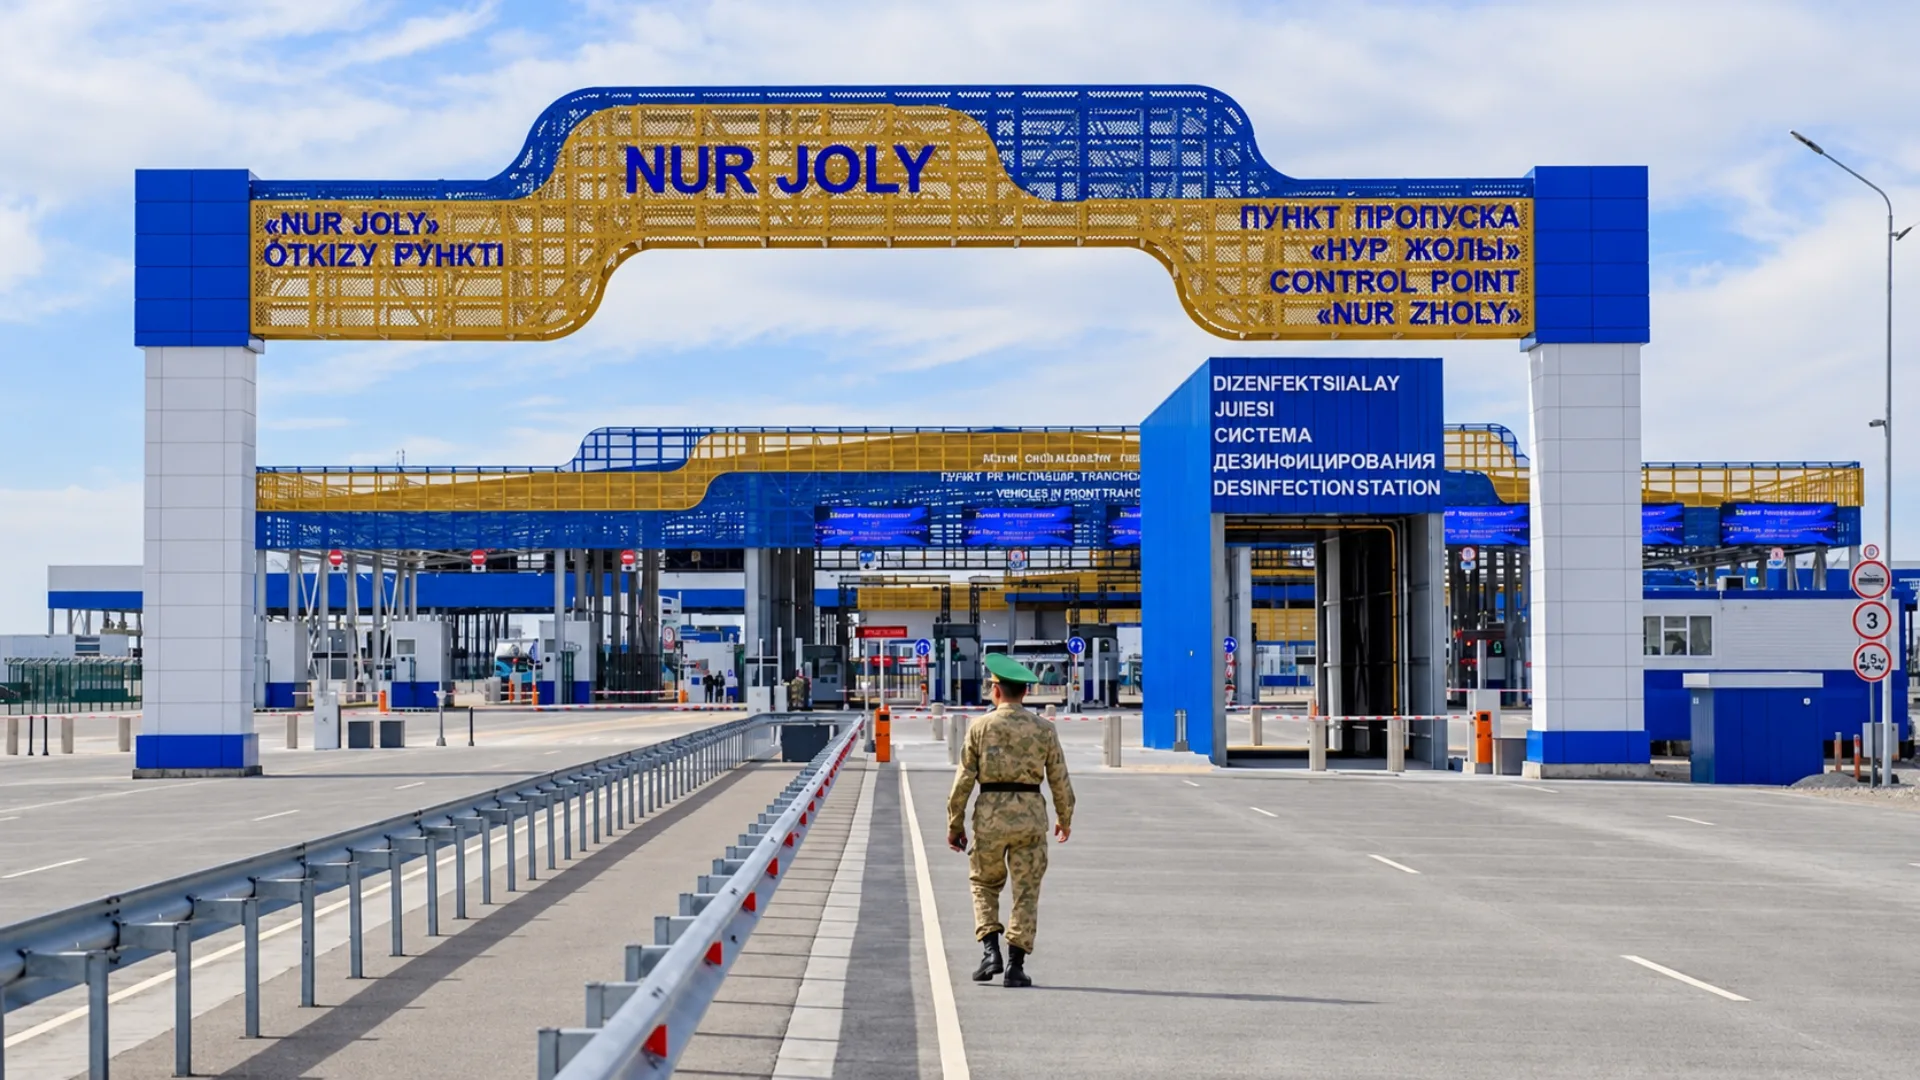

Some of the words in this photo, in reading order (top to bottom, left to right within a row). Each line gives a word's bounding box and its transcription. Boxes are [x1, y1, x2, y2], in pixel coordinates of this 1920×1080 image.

[626, 145, 758, 194] NUR
[776, 145, 936, 194] JOLY
[264, 211, 343, 235] «NUR
[353, 211, 440, 235] JOLY»
[1240, 205, 1340, 229] ПУНКТ
[1355, 205, 1520, 229] ПРОПУСКА
[1311, 237, 1388, 261] «НУР
[1405, 237, 1521, 261] ЖОЛЫ»
[1270, 269, 1418, 293] CONTROL
[1431, 269, 1520, 293] POINT
[1317, 301, 1395, 325] «NUR
[1409, 301, 1521, 325] ZHOLY»
[1213, 375, 1400, 391] DIZENFEKTSIIALAY
[1215, 401, 1274, 417] JUIESI
[1214, 427, 1313, 443] СИСТЕМА
[1213, 453, 1435, 473] ДЕЗИНФИЦИРОВАНИЯ
[1213, 480, 1354, 496] DESINFECTION
[1356, 480, 1441, 496] STATION
[1866, 612, 1878, 629] 3
